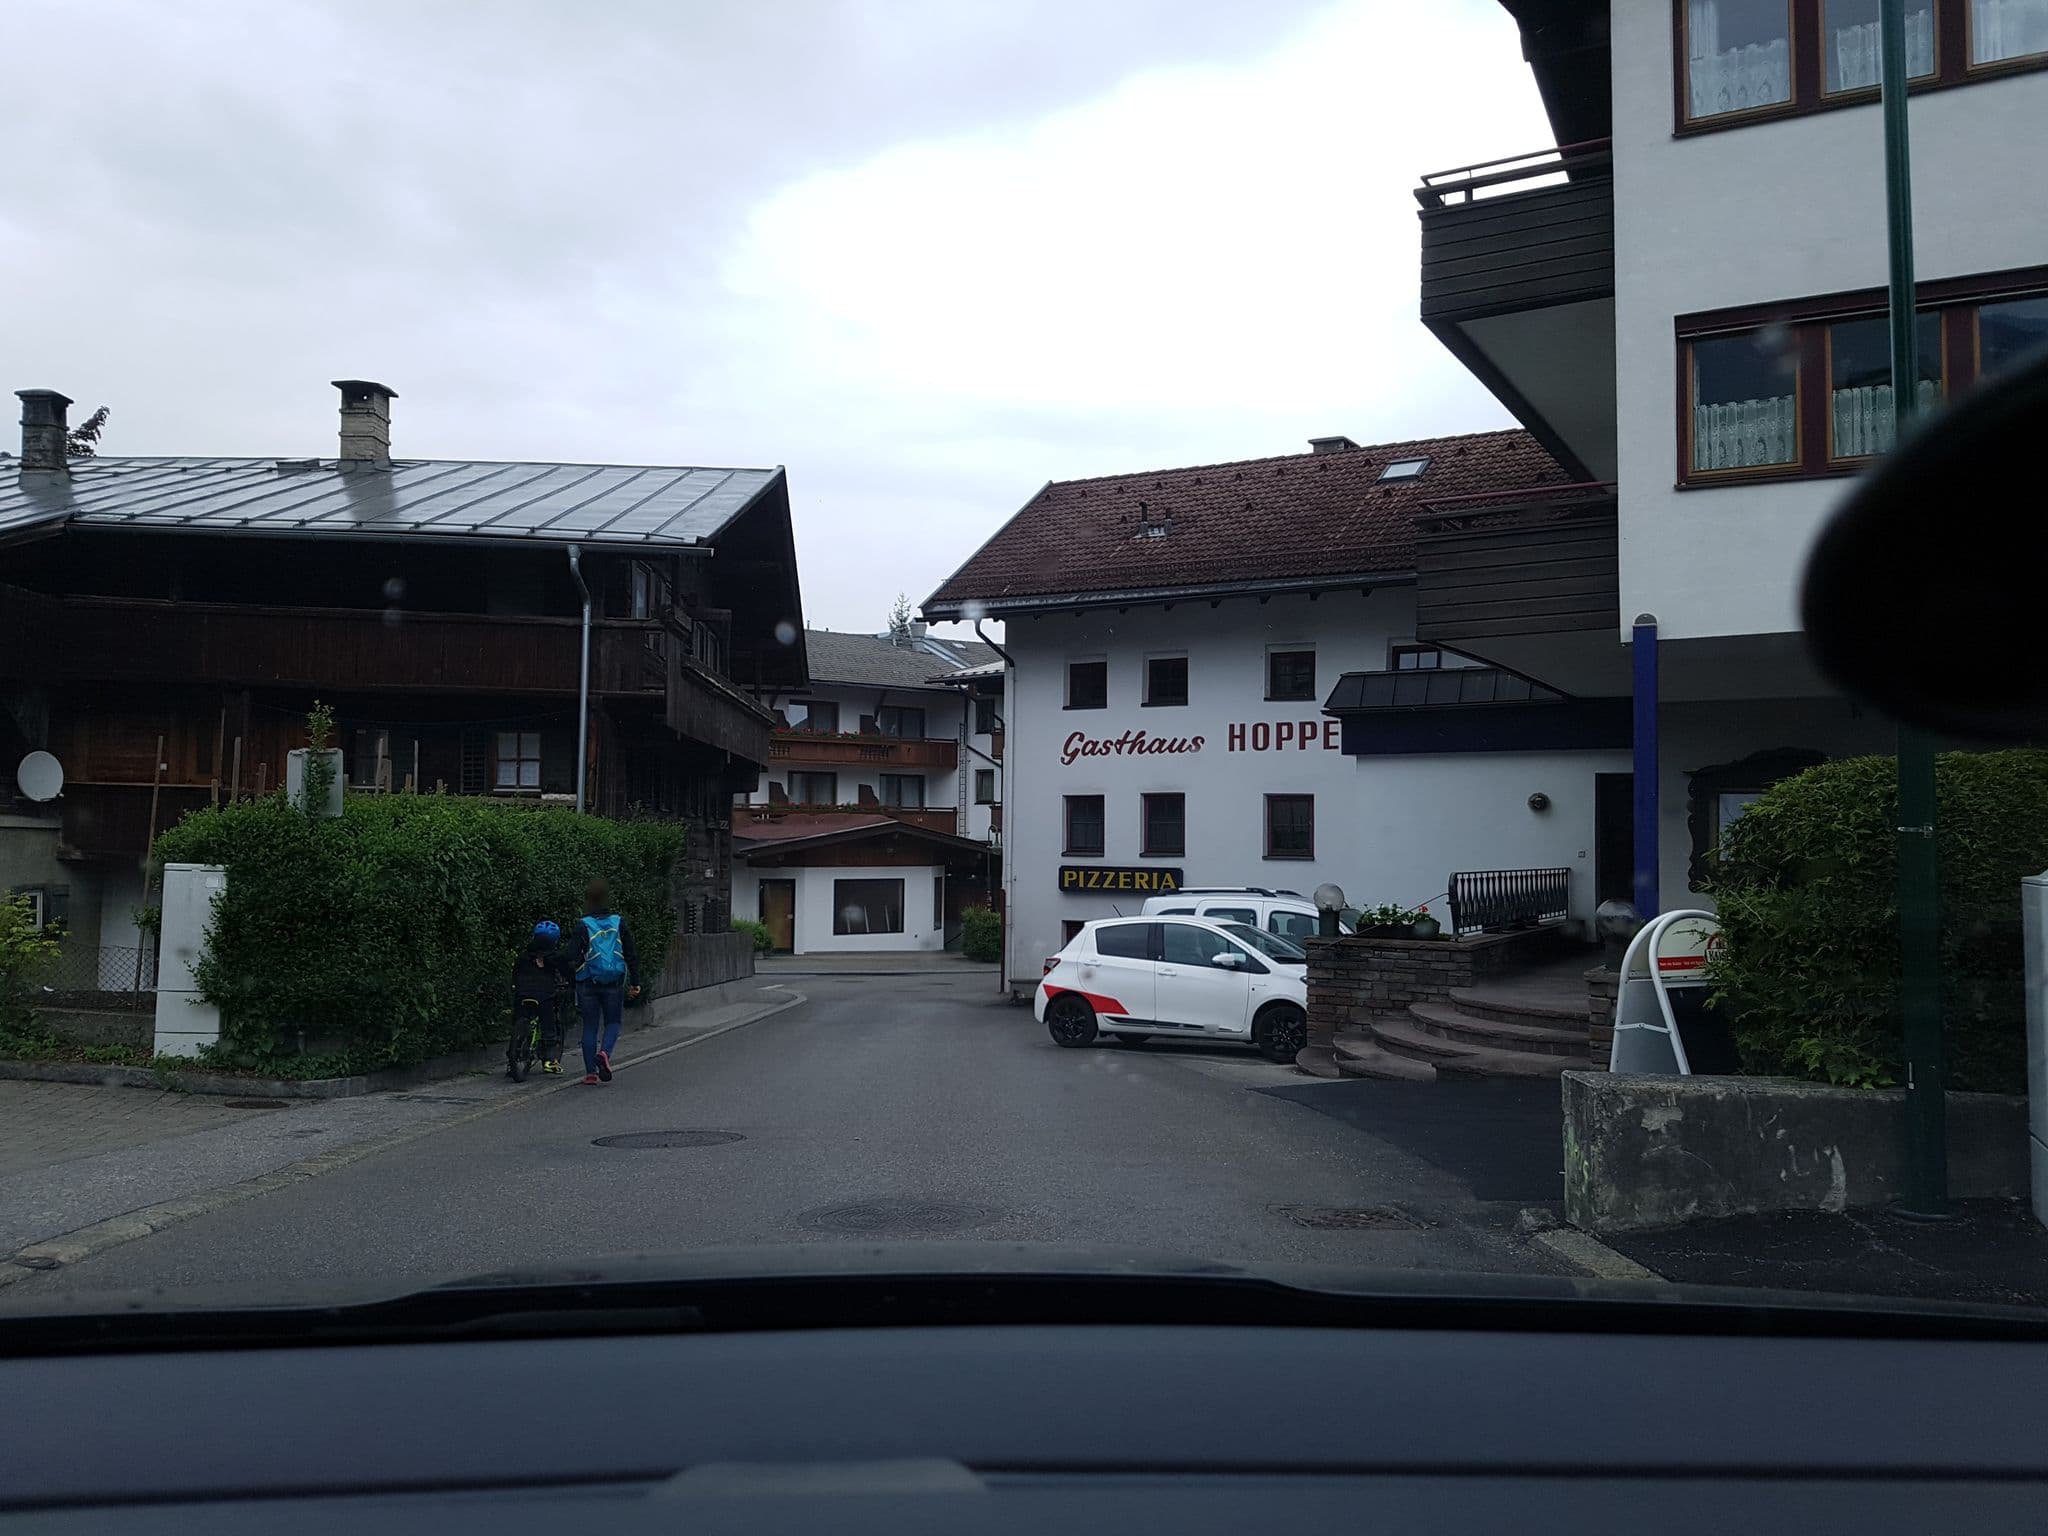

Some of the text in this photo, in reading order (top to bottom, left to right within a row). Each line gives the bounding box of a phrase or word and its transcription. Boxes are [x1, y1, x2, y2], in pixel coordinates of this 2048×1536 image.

[1061, 720, 1342, 765] Gasthaus HOPPE
[1063, 871, 1177, 890] PIZZERIA
